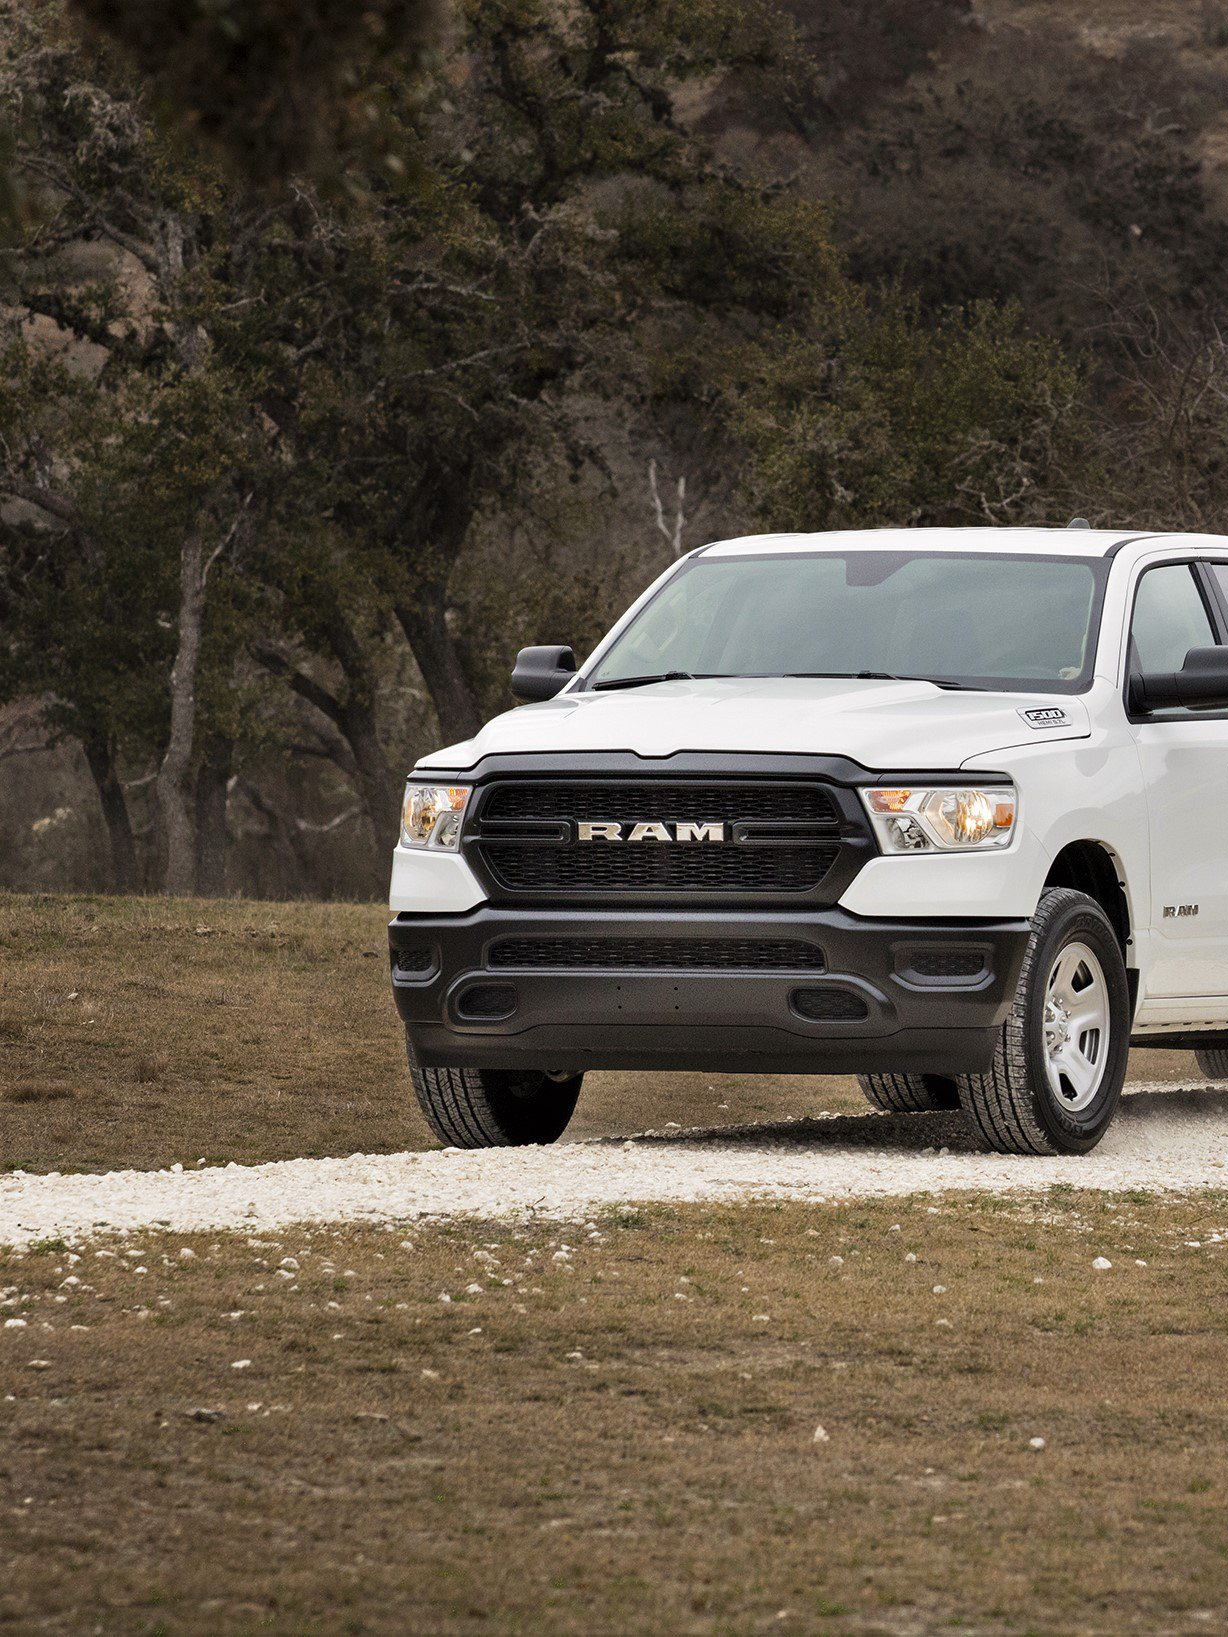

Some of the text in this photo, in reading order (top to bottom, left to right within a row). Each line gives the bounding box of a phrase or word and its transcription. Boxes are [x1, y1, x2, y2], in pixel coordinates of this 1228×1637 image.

[1026, 709, 1064, 720] 1500
[577, 822, 725, 842] RAM
[1163, 904, 1199, 918] RAM
